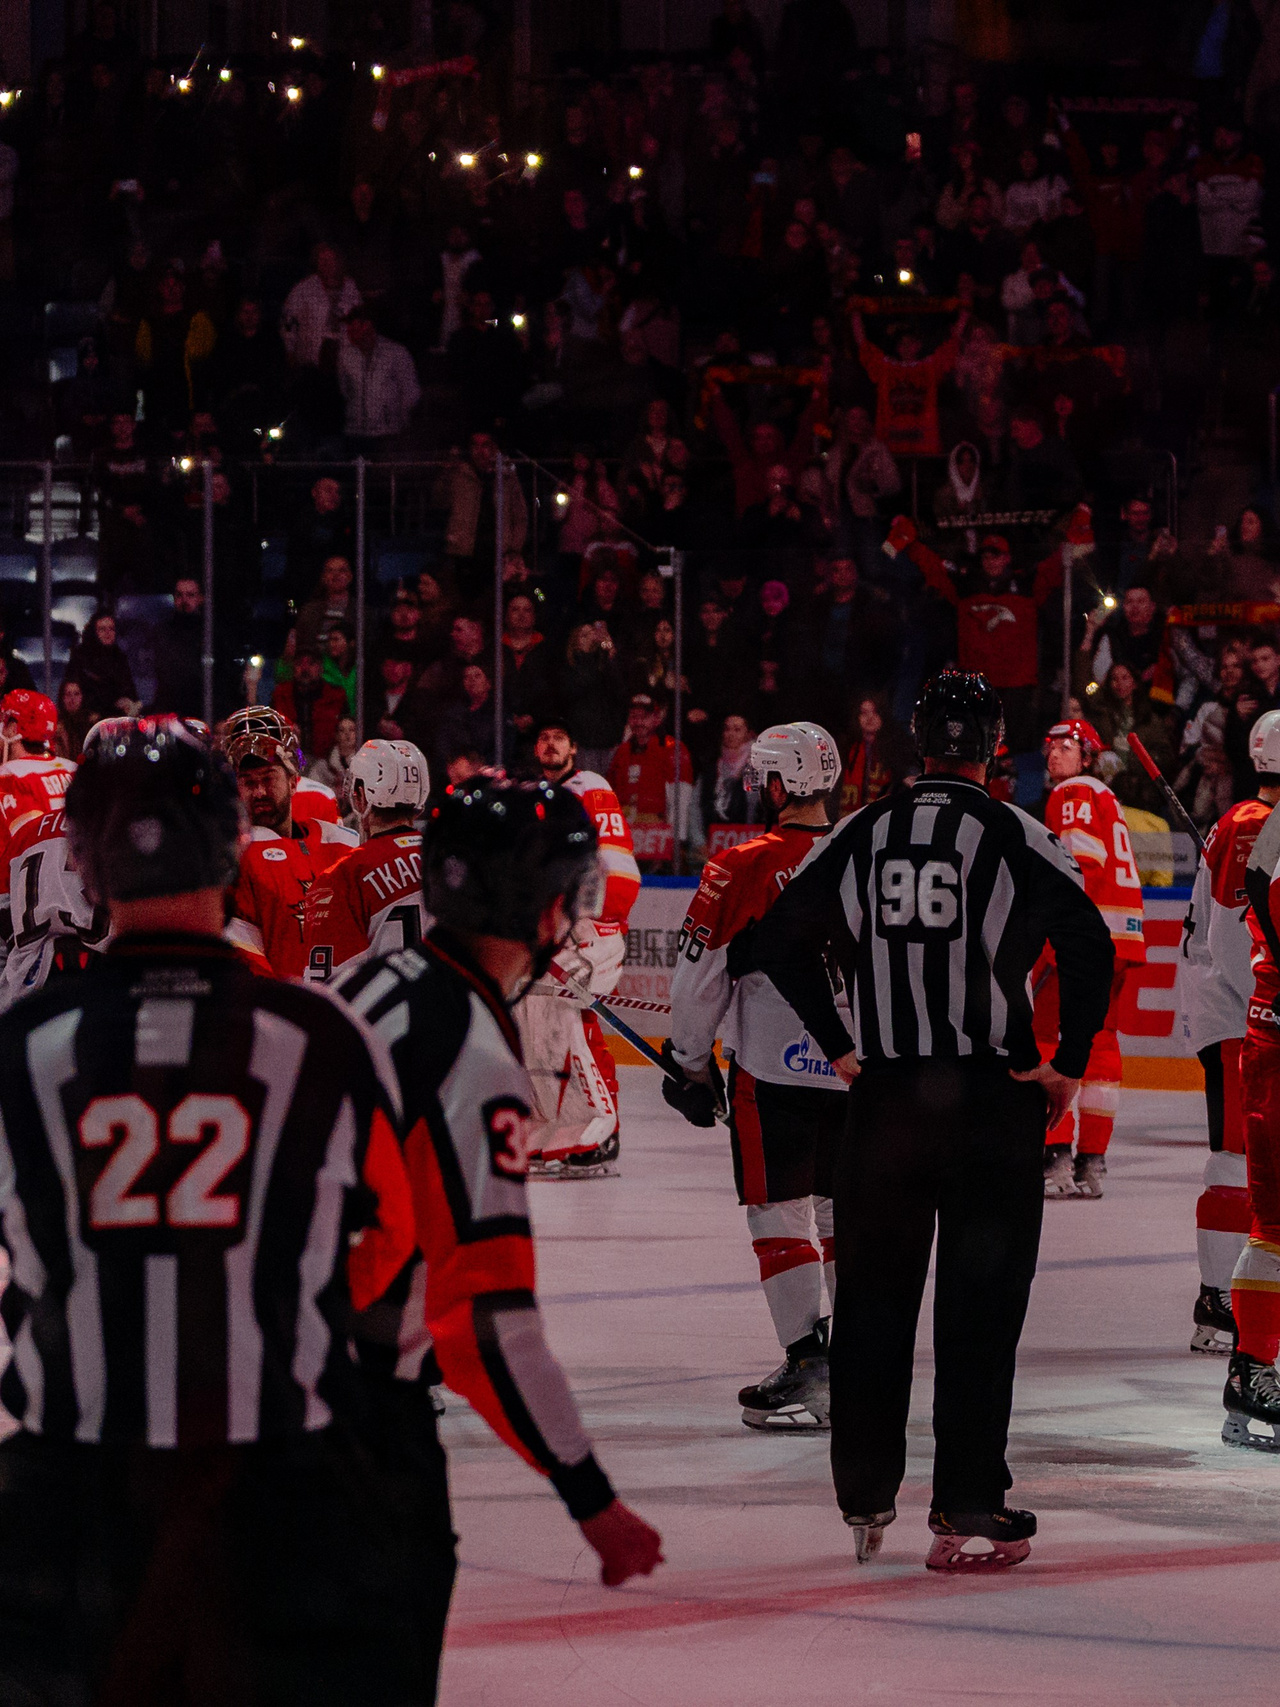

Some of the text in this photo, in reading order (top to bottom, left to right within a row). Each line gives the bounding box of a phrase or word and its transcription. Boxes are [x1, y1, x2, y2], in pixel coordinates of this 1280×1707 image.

[820, 753, 835, 771] 66
[403, 766, 420, 784] 19
[595, 812, 626, 838] 29
[1061, 801, 1093, 826] 94
[880, 858, 959, 928] 96
[78, 1092, 251, 1230] 22
